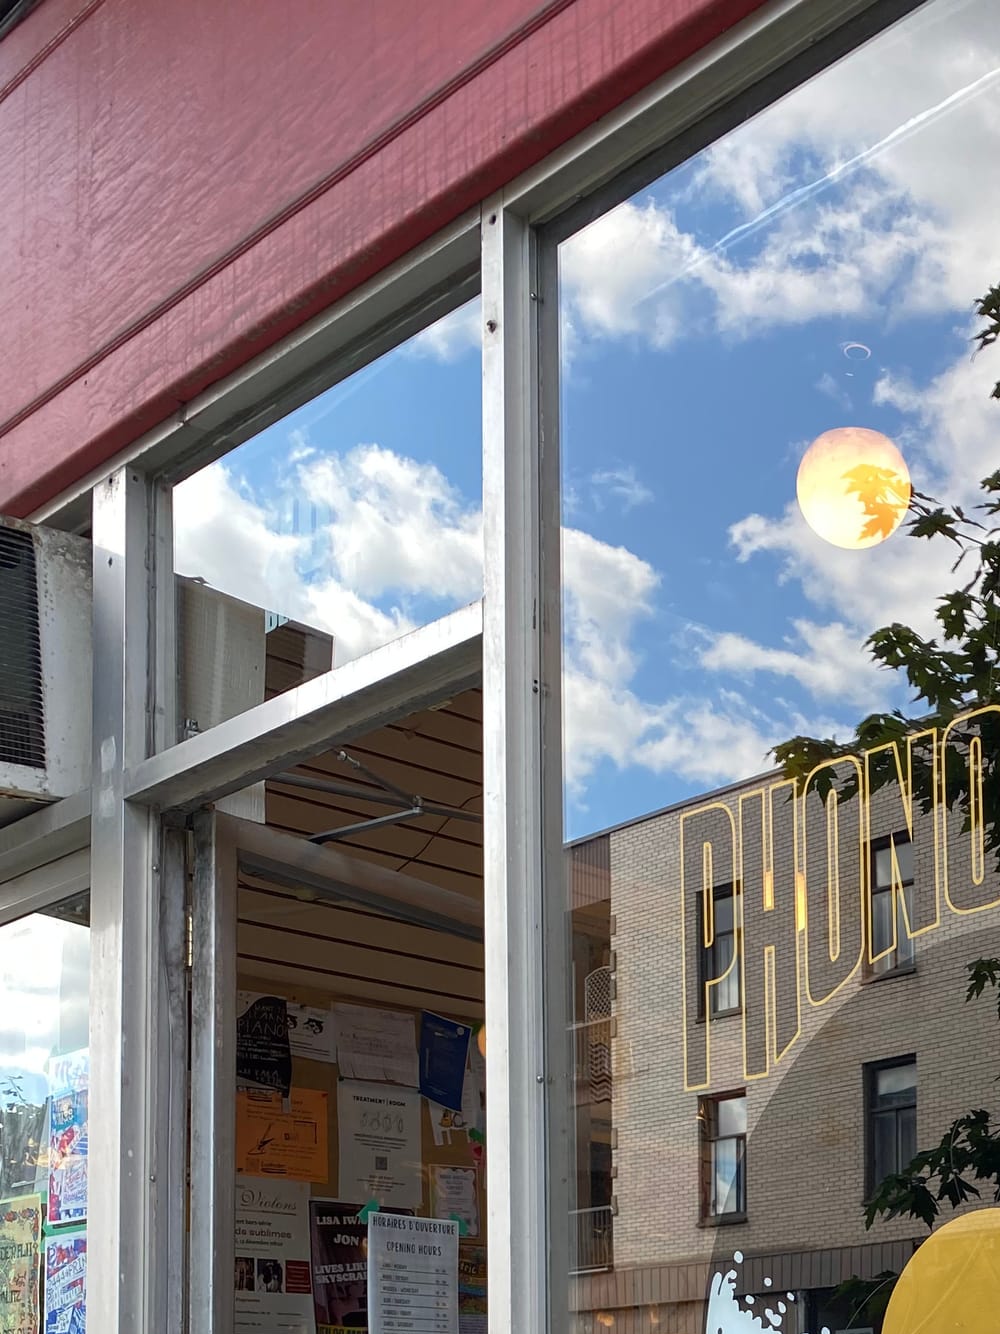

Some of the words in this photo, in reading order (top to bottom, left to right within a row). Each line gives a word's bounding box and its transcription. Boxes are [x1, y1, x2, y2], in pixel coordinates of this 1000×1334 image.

[237, 1019, 284, 1037] PIANO
[352, 1095, 386, 1105] TREATMENT
[240, 1188, 297, 1211] Violons
[316, 1215, 341, 1226] LISA
[372, 1215, 407, 1230] HORAIRES
[249, 1228, 292, 1239] sublimes
[333, 1233, 360, 1246] JON
[386, 1240, 416, 1254] OPENING
[417, 1245, 442, 1257] HOURS
[315, 1264, 344, 1275] LIVES
